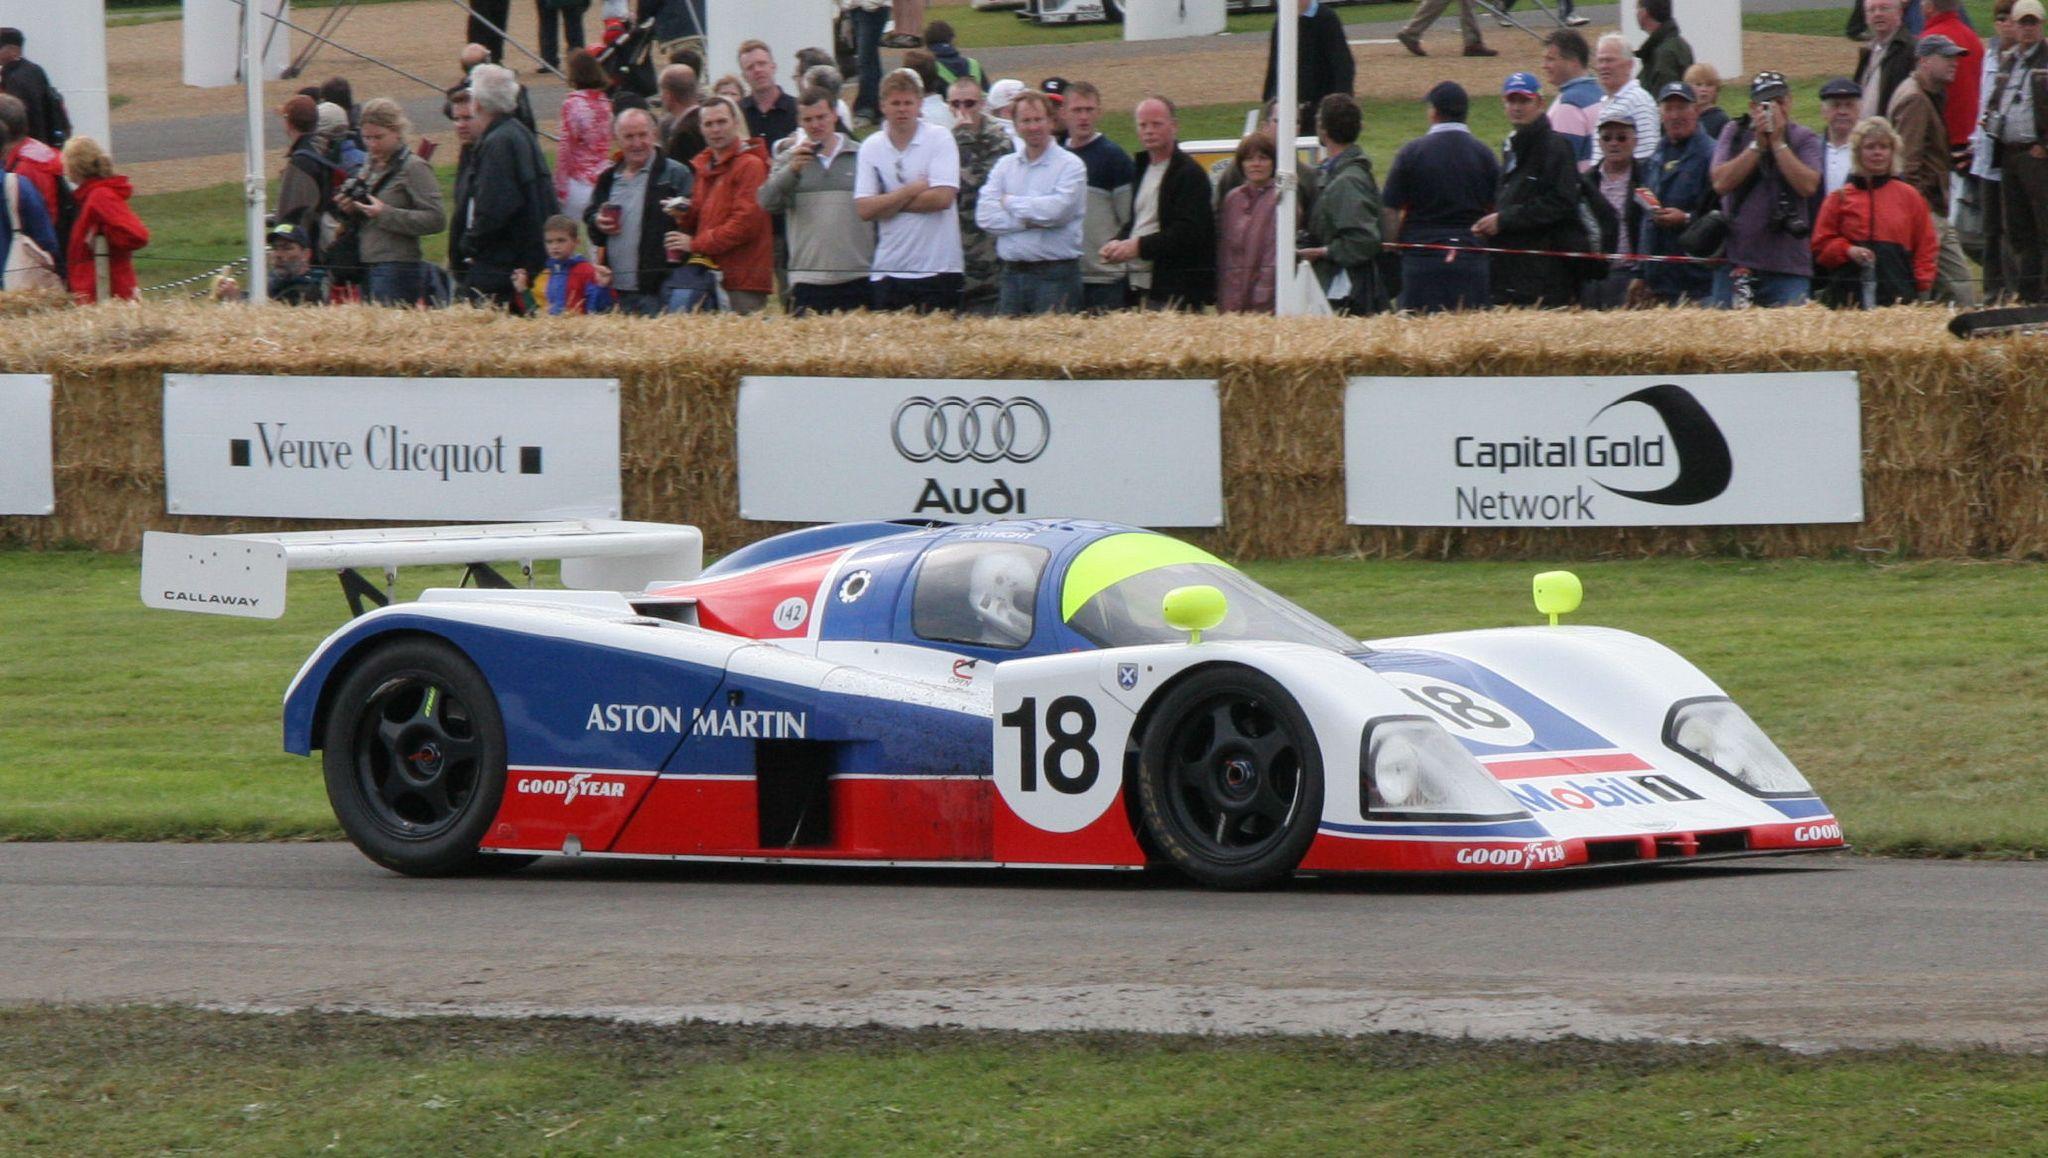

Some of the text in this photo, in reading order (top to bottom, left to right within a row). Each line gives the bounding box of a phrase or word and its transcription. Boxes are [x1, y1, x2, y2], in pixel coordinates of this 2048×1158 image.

[254, 421, 506, 482] Veuve Clicquot
[1455, 434, 1666, 474] Capital Gold
[913, 477, 1027, 515] Audi
[1456, 485, 1596, 521] Network
[163, 590, 260, 606] CALLAWAY
[778, 604, 802, 621] 142
[586, 703, 806, 739] ASTON MARTIN
[1399, 685, 1512, 729] 18
[1001, 694, 1100, 795] 18
[1507, 776, 1701, 813] Mobil 1
